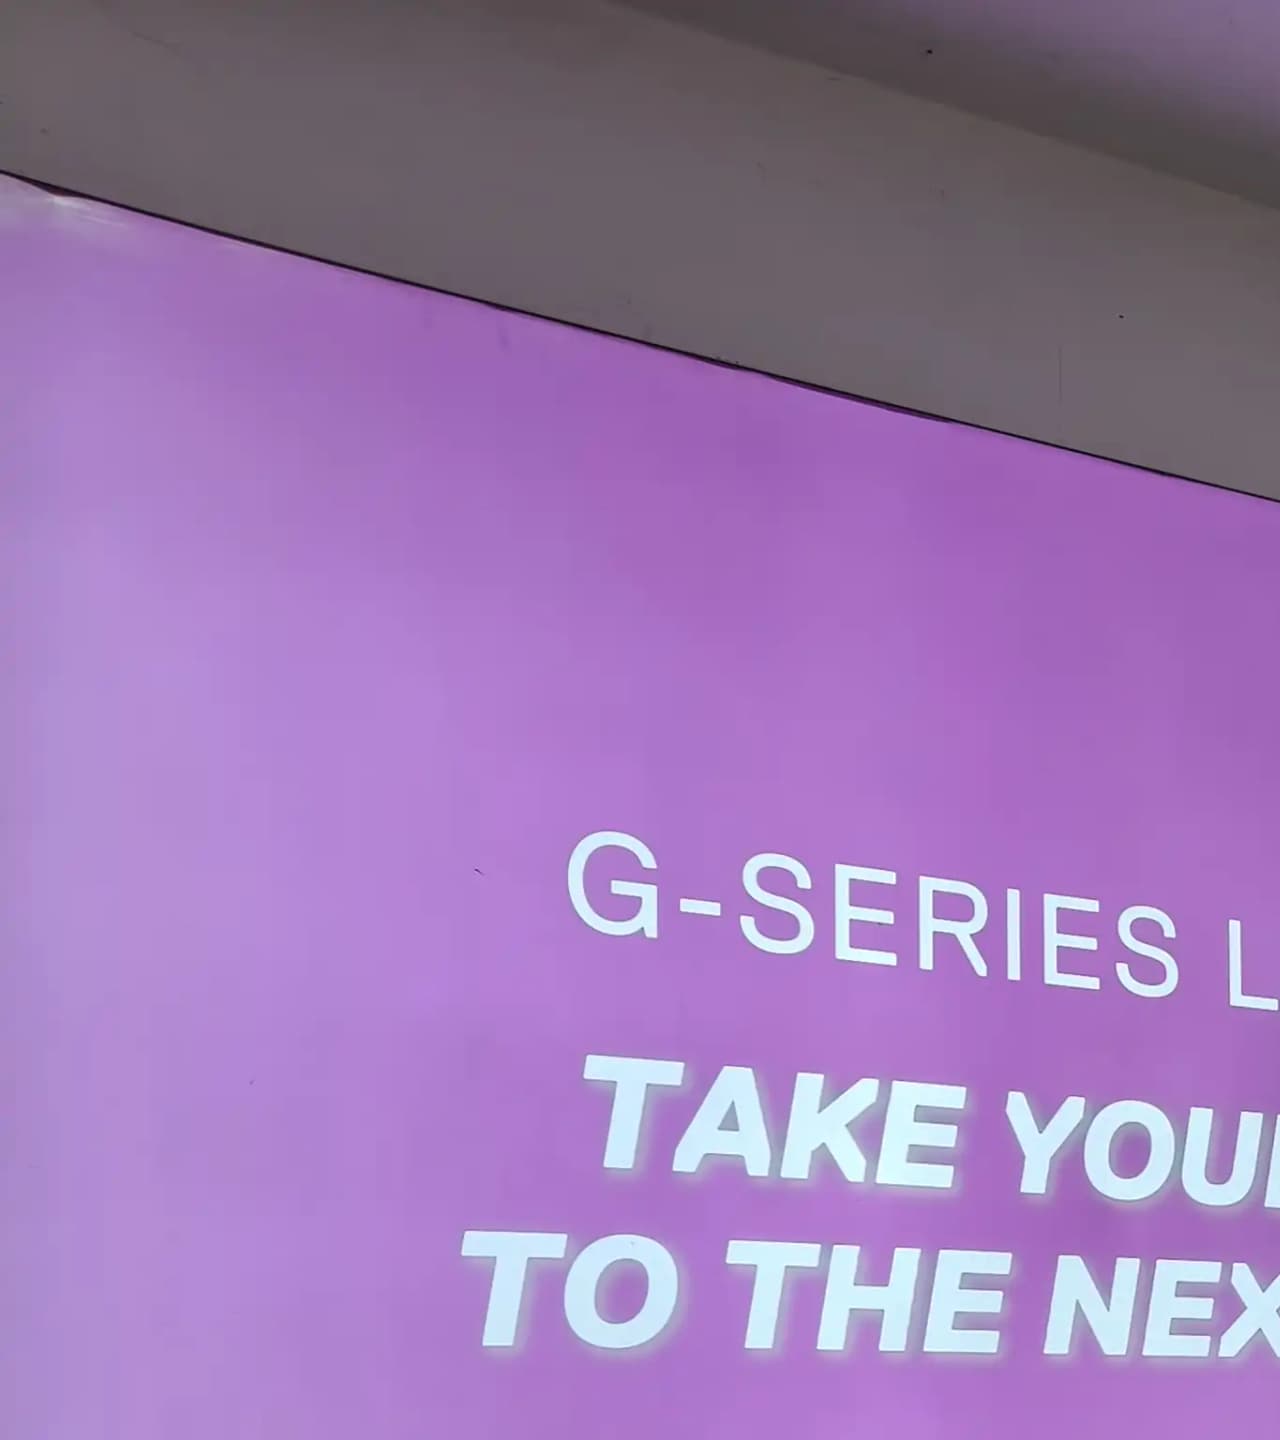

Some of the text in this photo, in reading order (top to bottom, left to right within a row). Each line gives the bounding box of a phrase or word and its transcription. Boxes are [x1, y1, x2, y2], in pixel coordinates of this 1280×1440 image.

[566, 830, 1179, 999] G-SERIES
[582, 1053, 966, 1189] TAKE
[461, 1230, 679, 1350] TO
[725, 1239, 1012, 1354] THE
